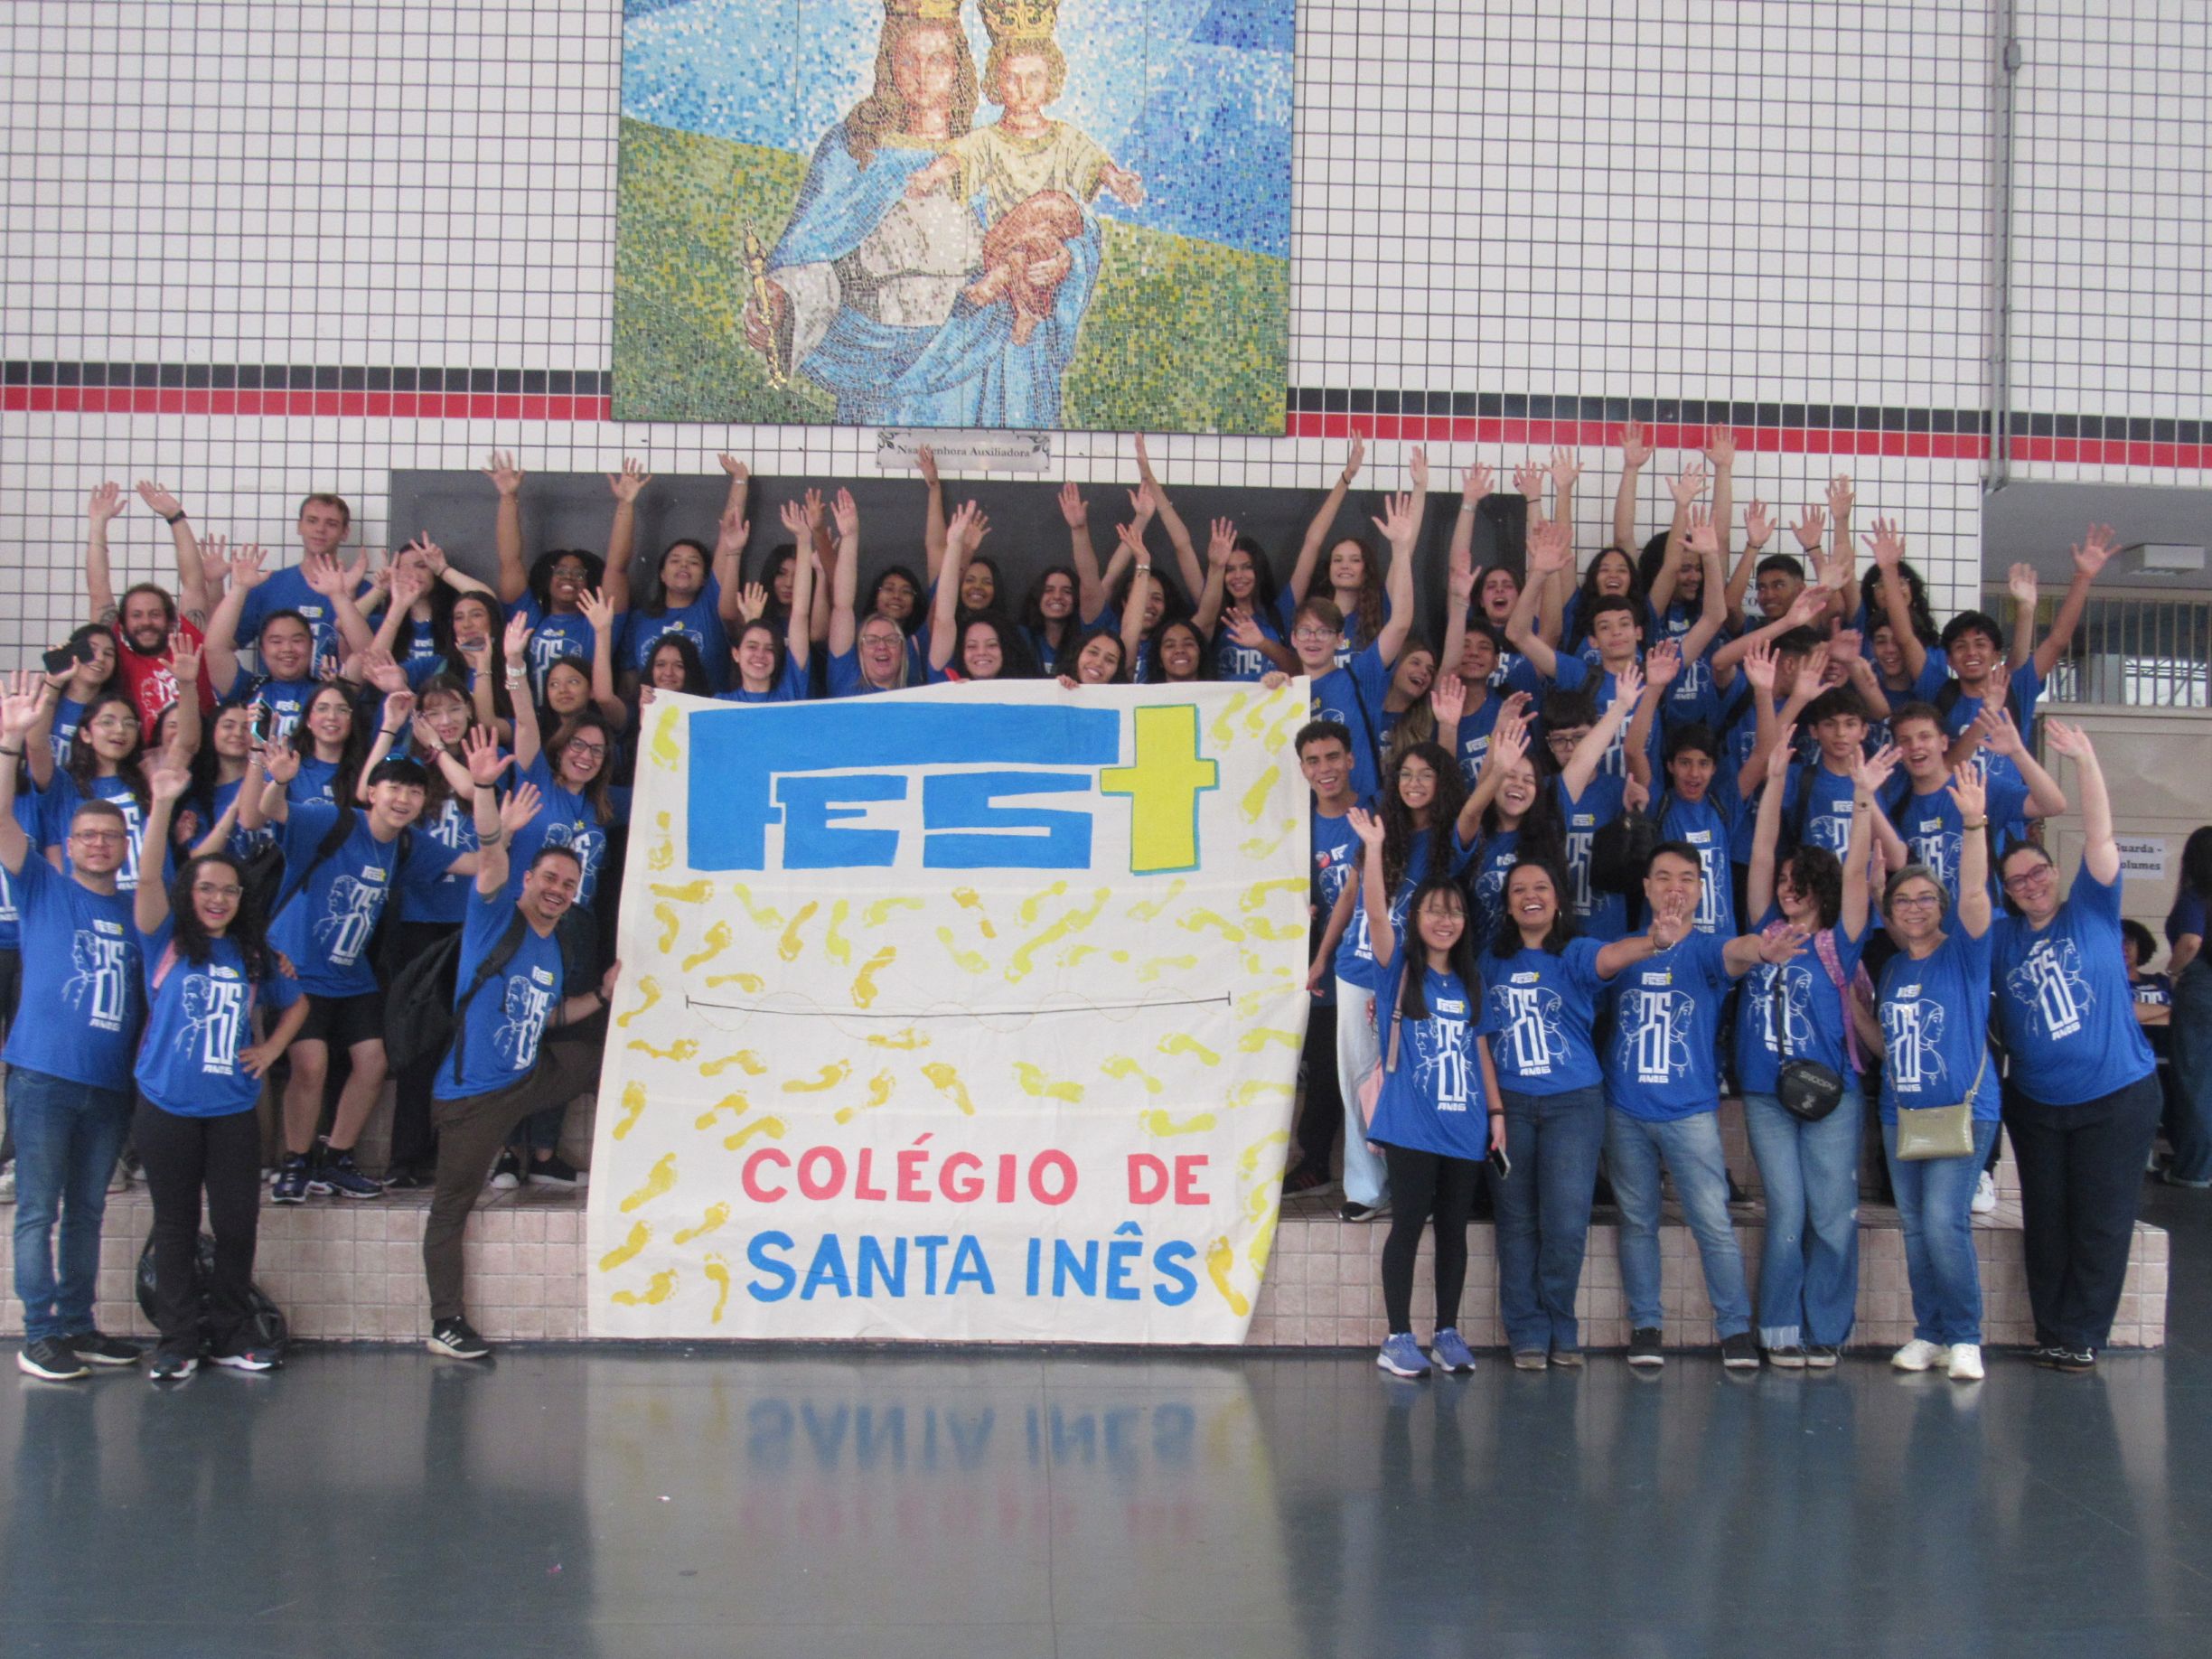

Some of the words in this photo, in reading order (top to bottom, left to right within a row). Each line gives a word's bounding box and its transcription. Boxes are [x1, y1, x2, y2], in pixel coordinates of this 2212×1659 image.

[932, 445, 967, 455] enhora
[970, 446, 1030, 458] Auxiliadora
[2120, 859, 2160, 871] olumes
[742, 1132, 1078, 1205] COLÉGIO
[1128, 1153, 1210, 1205] DE
[746, 1230, 995, 1302] SANTA
[1026, 1221, 1198, 1307] INÊS
